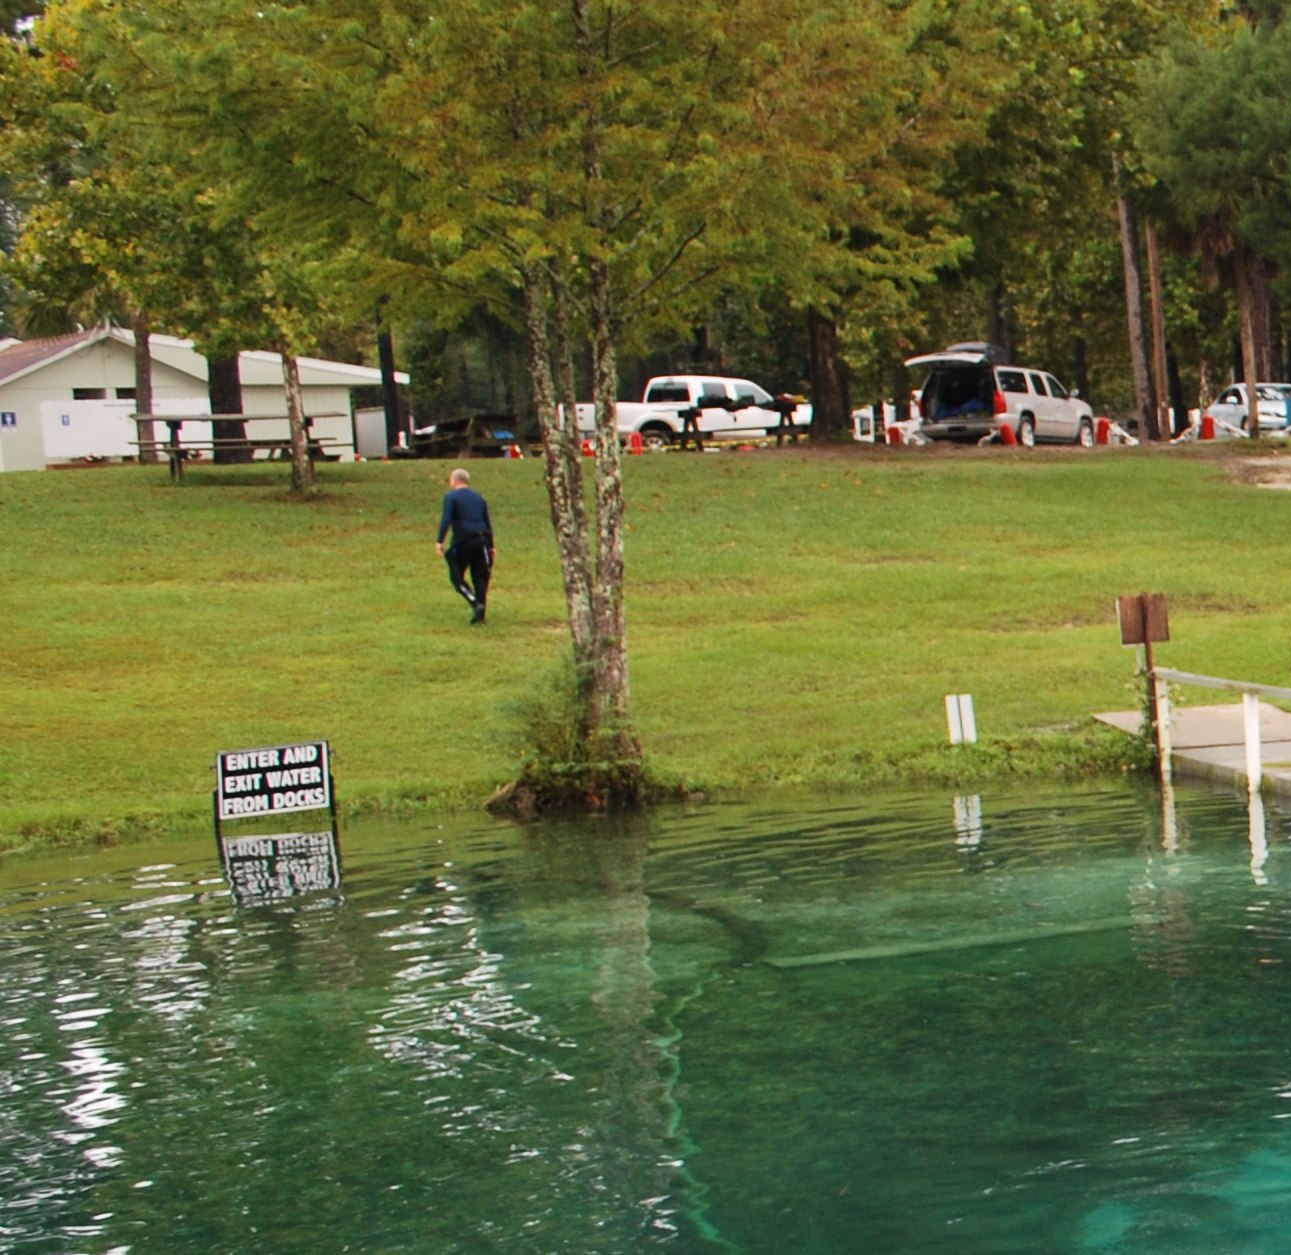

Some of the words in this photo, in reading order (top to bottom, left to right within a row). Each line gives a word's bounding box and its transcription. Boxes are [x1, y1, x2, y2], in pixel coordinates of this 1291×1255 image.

[226, 750, 280, 771] ENTER
[283, 745, 318, 765] AND
[224, 773, 262, 793] EXIT
[266, 766, 321, 788] WATER
[223, 794, 269, 815] FROM
[273, 787, 325, 809] DOCKS
